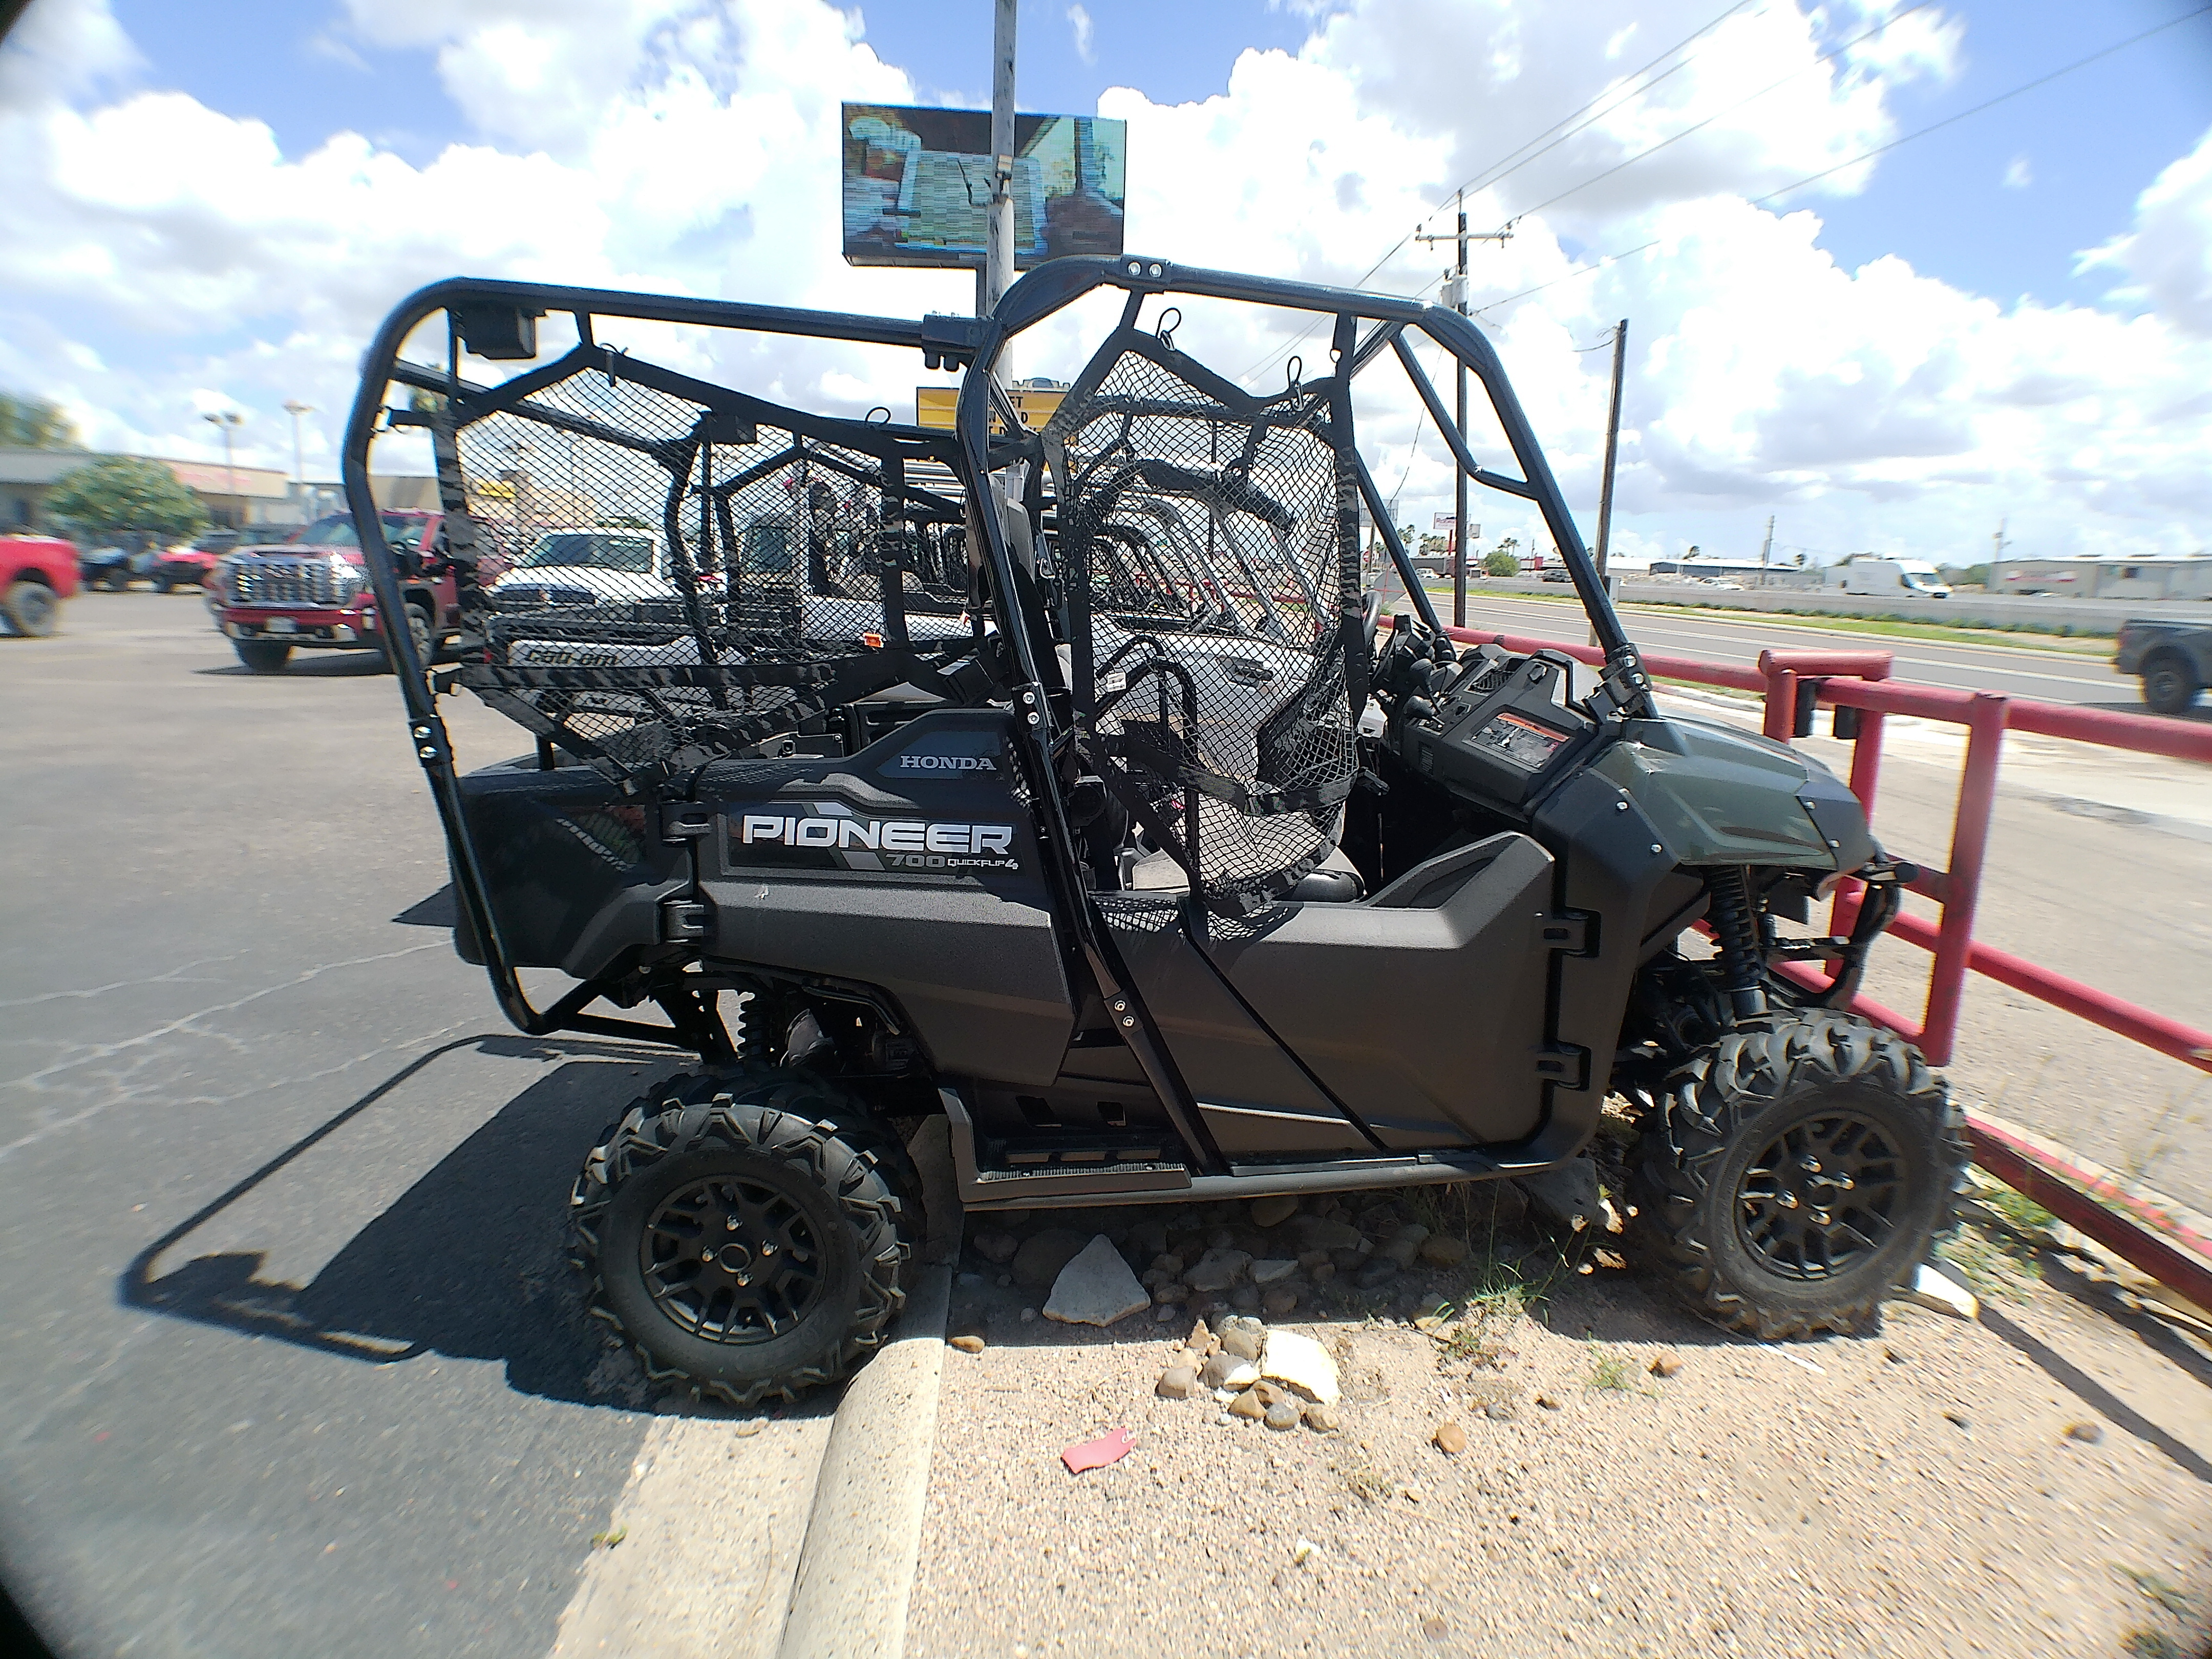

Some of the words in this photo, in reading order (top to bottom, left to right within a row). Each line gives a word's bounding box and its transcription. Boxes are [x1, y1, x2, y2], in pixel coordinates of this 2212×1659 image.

[900, 756, 996, 770] HONDA
[742, 815, 1013, 855] PIONEER
[885, 854, 945, 867] 700
